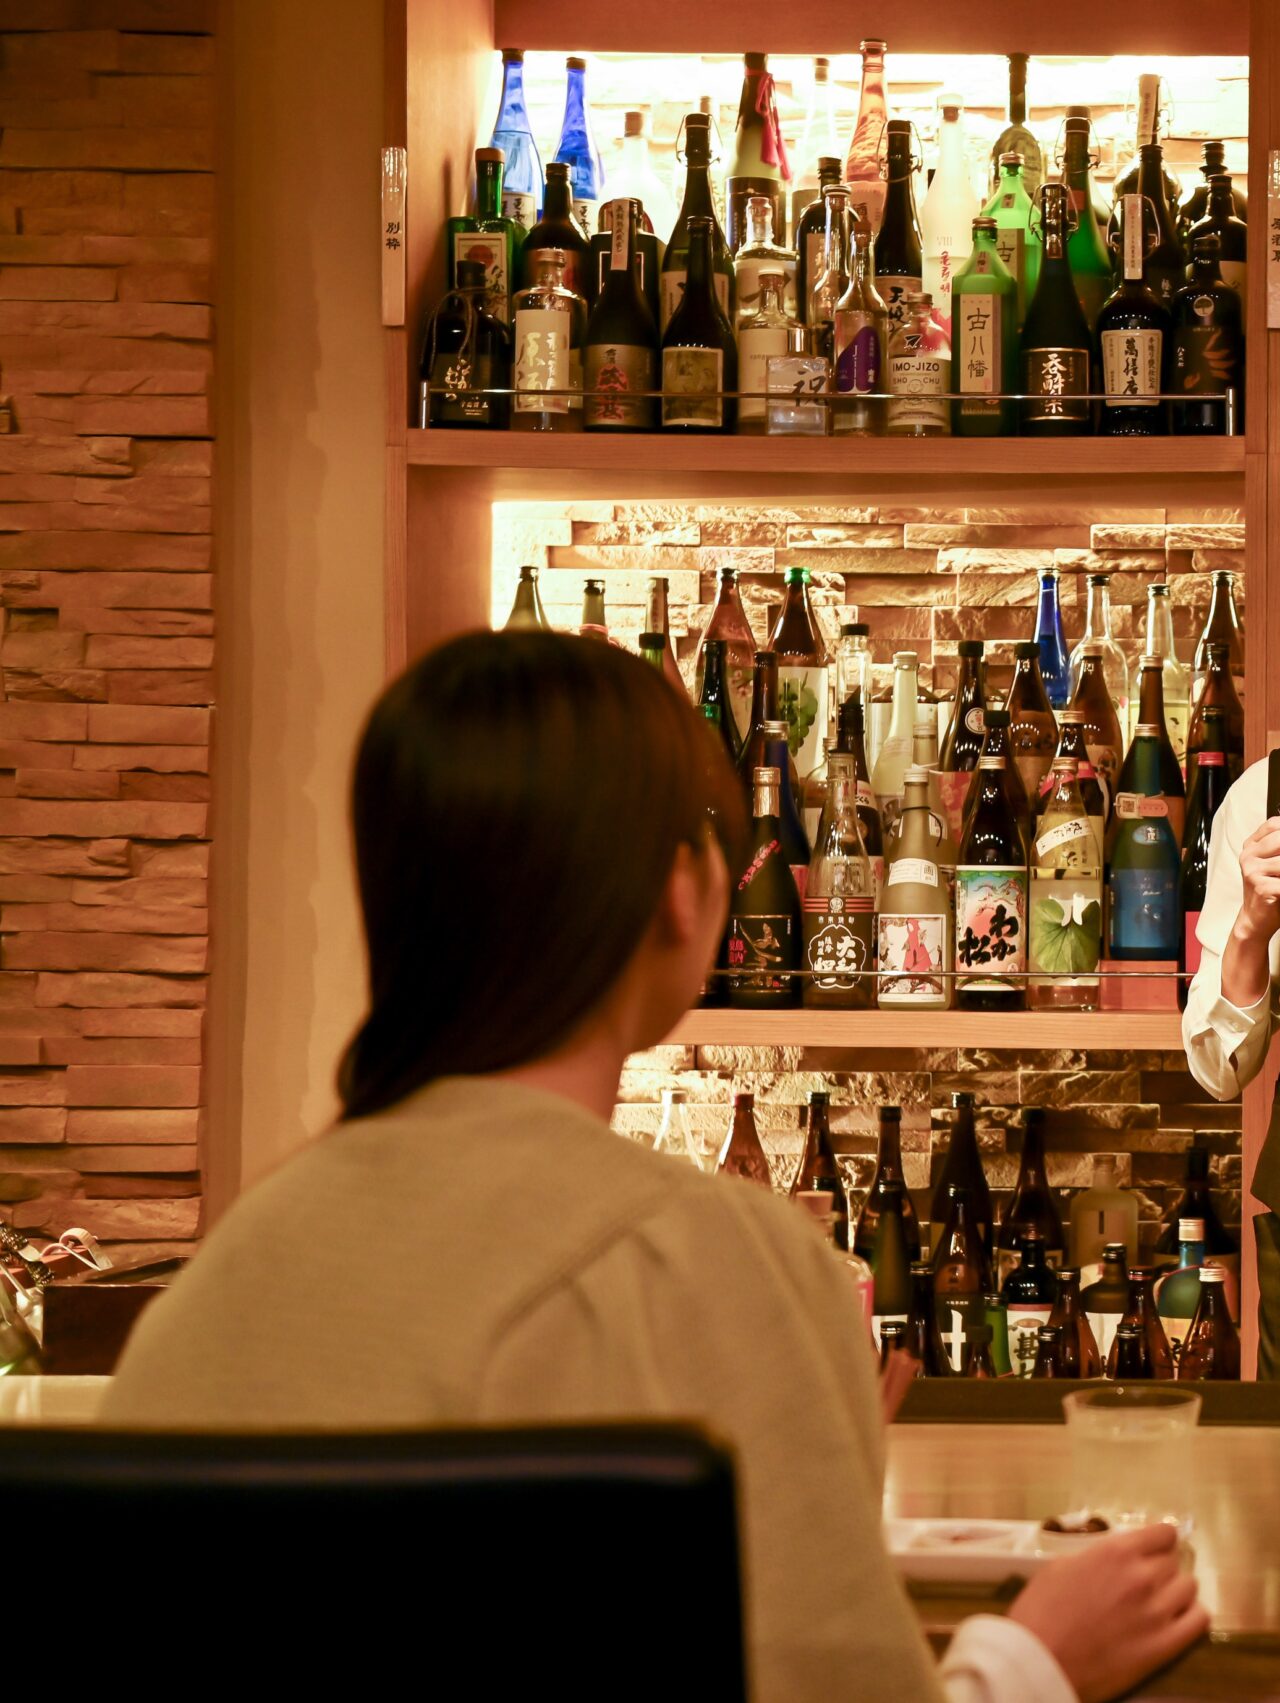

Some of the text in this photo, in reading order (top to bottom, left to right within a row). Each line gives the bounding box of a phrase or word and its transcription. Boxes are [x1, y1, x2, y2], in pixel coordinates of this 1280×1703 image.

[385, 222, 400, 250] 別枠
[966, 308, 991, 380] 古八幡
